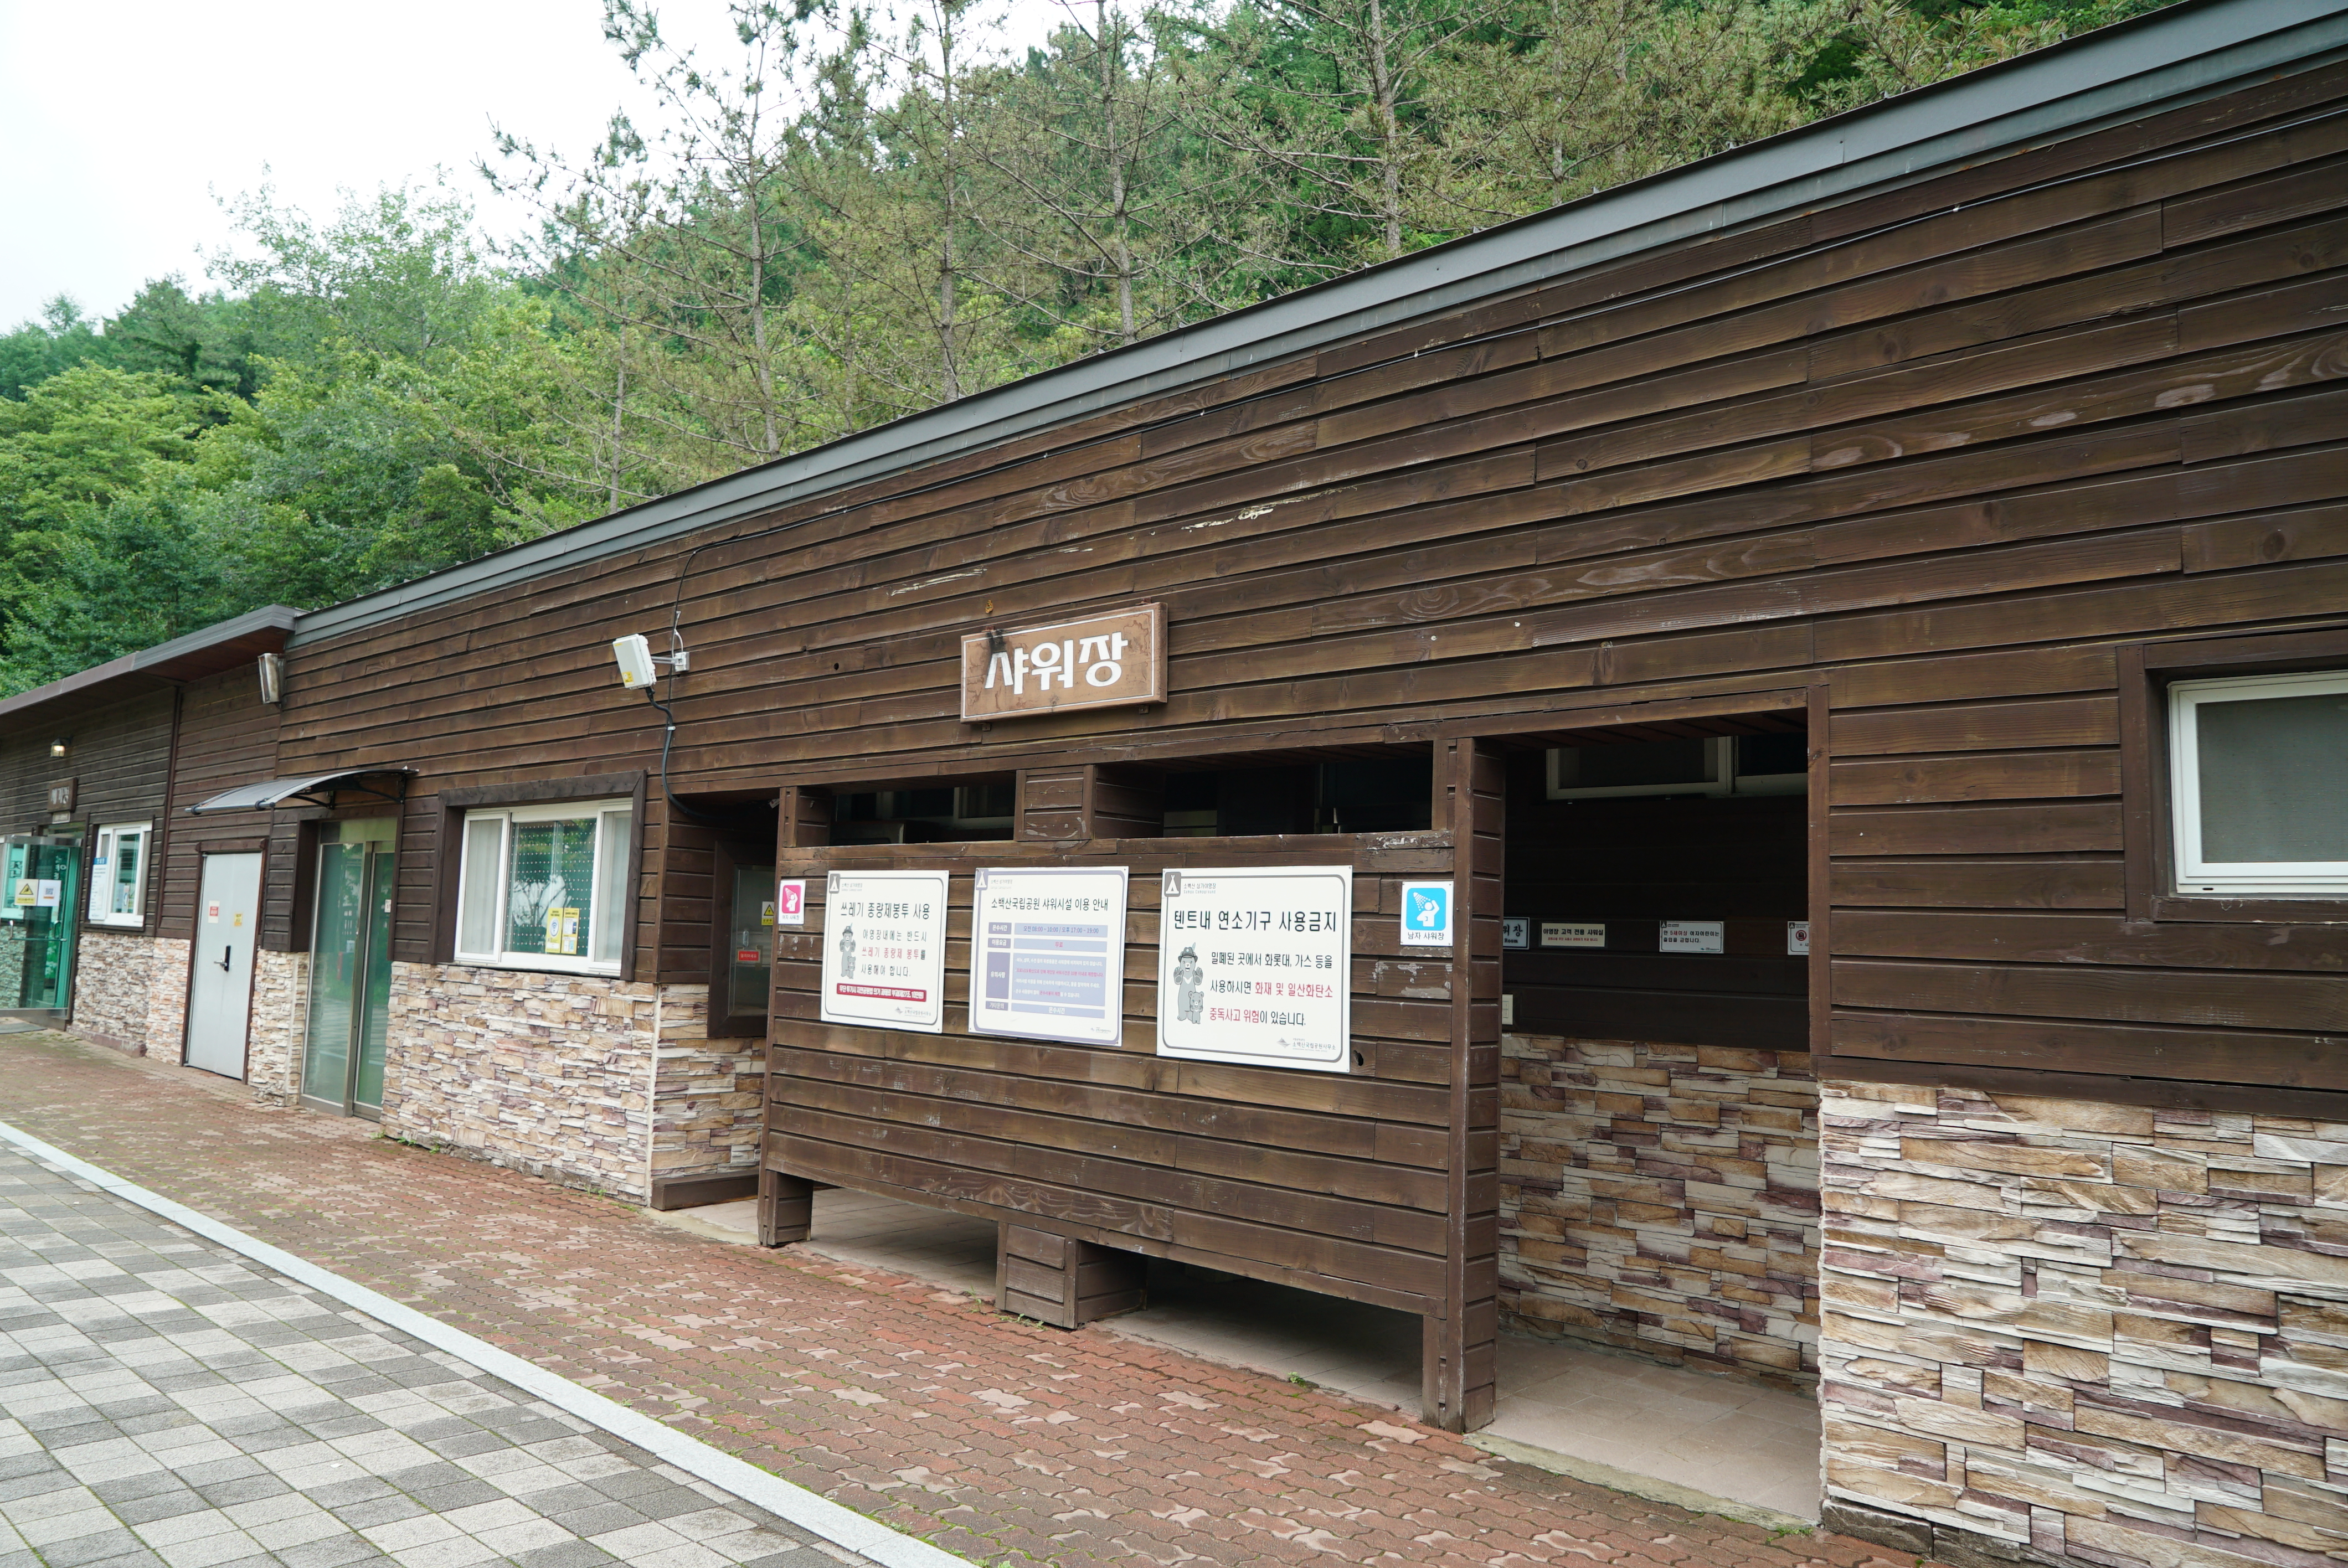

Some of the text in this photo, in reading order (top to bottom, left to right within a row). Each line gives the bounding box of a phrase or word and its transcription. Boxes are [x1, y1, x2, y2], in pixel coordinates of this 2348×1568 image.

[985, 632, 1128, 695] 샤워장
[841, 902, 930, 920] 쓰레기 종량제봉투 사용
[991, 898, 1108, 911] 소백산국립공원 샤워시설 이용 안내
[1174, 910, 1337, 932] 텐트내 연소기구 사용금지
[863, 929, 927, 942] 야영장내에는 반드시
[1408, 932, 1444, 940] 남자 샤워장
[862, 946, 926, 960] 쓰레기 종량제 봉투를
[1211, 952, 1333, 969] 밀폐된 곳에서 화롯대, 가스 등을
[861, 964, 912, 977] 사용해야 합니다.
[1210, 979, 1333, 998] 사용하시면 화재 및 일산화탄소
[1209, 1008, 1306, 1026] 중독사고 위험이 있습니다.
[1293, 1041, 1336, 1050] 소백산국립공원사무소
